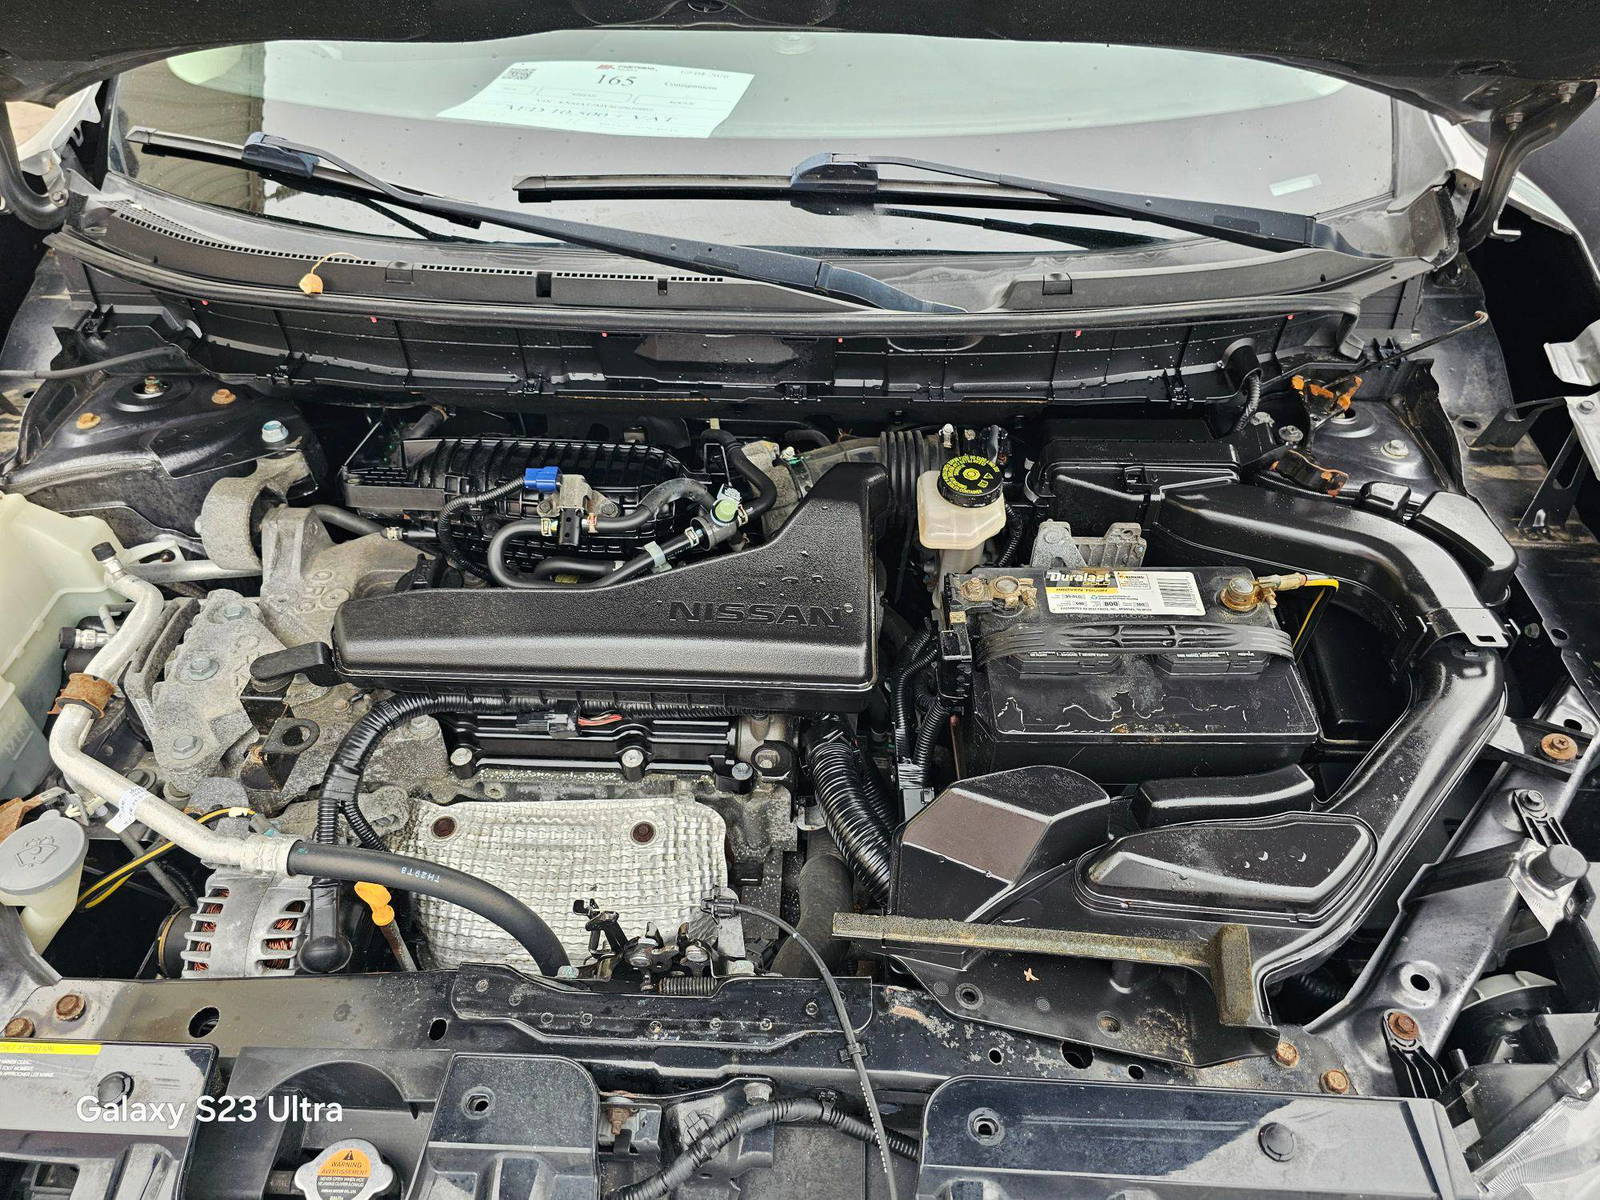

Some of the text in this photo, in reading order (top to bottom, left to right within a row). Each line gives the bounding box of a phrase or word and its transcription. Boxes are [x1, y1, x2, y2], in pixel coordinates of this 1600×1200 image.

[598, 74, 637, 86] 165
[1046, 571, 1111, 582] Duralast
[669, 601, 842, 628] NISSAN
